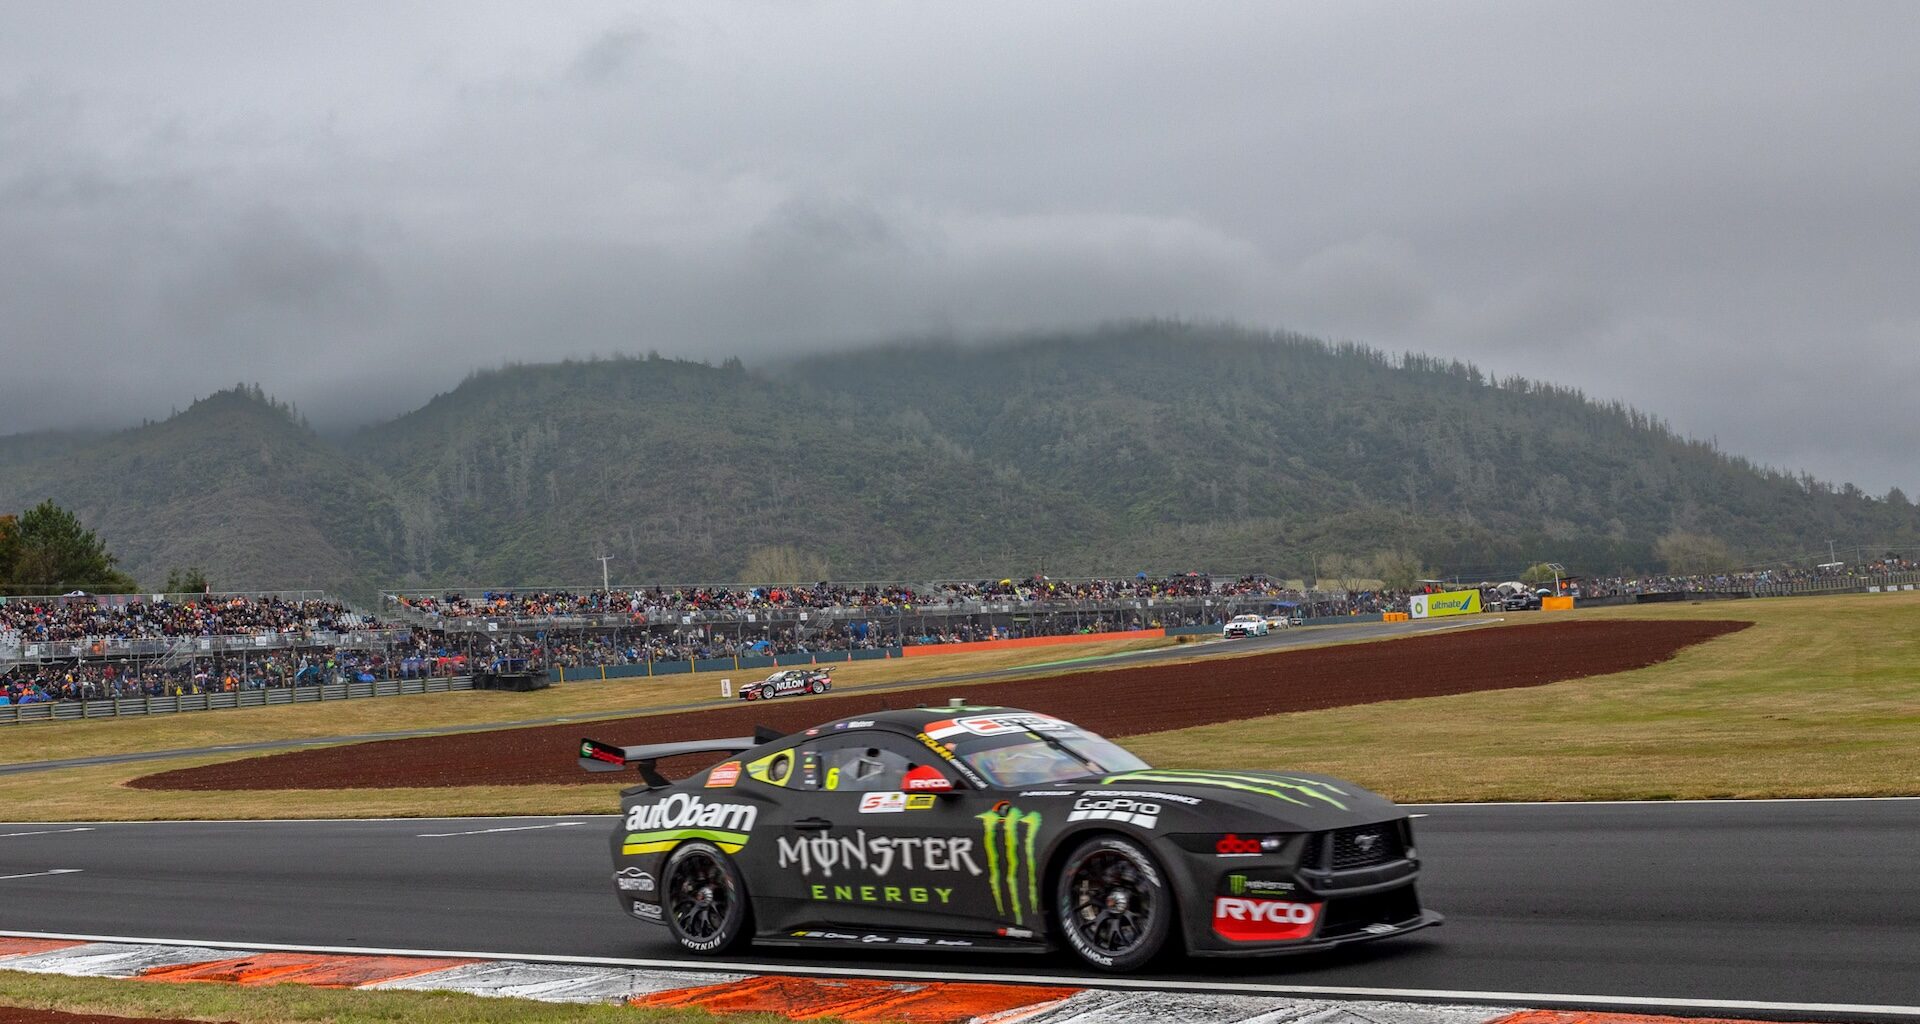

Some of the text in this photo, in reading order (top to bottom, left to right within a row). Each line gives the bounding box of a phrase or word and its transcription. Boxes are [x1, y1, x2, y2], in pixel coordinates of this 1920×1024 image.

[1431, 599, 1461, 611] ultimate
[776, 679, 805, 691] NULON
[825, 767, 840, 790] 6
[910, 778, 951, 789] RYCO
[1074, 798, 1162, 815] GoPro
[776, 829, 982, 877] MONSTER
[811, 884, 953, 903] ENERGY
[633, 900, 663, 915] FORD
[1216, 897, 1316, 925] RYCO
